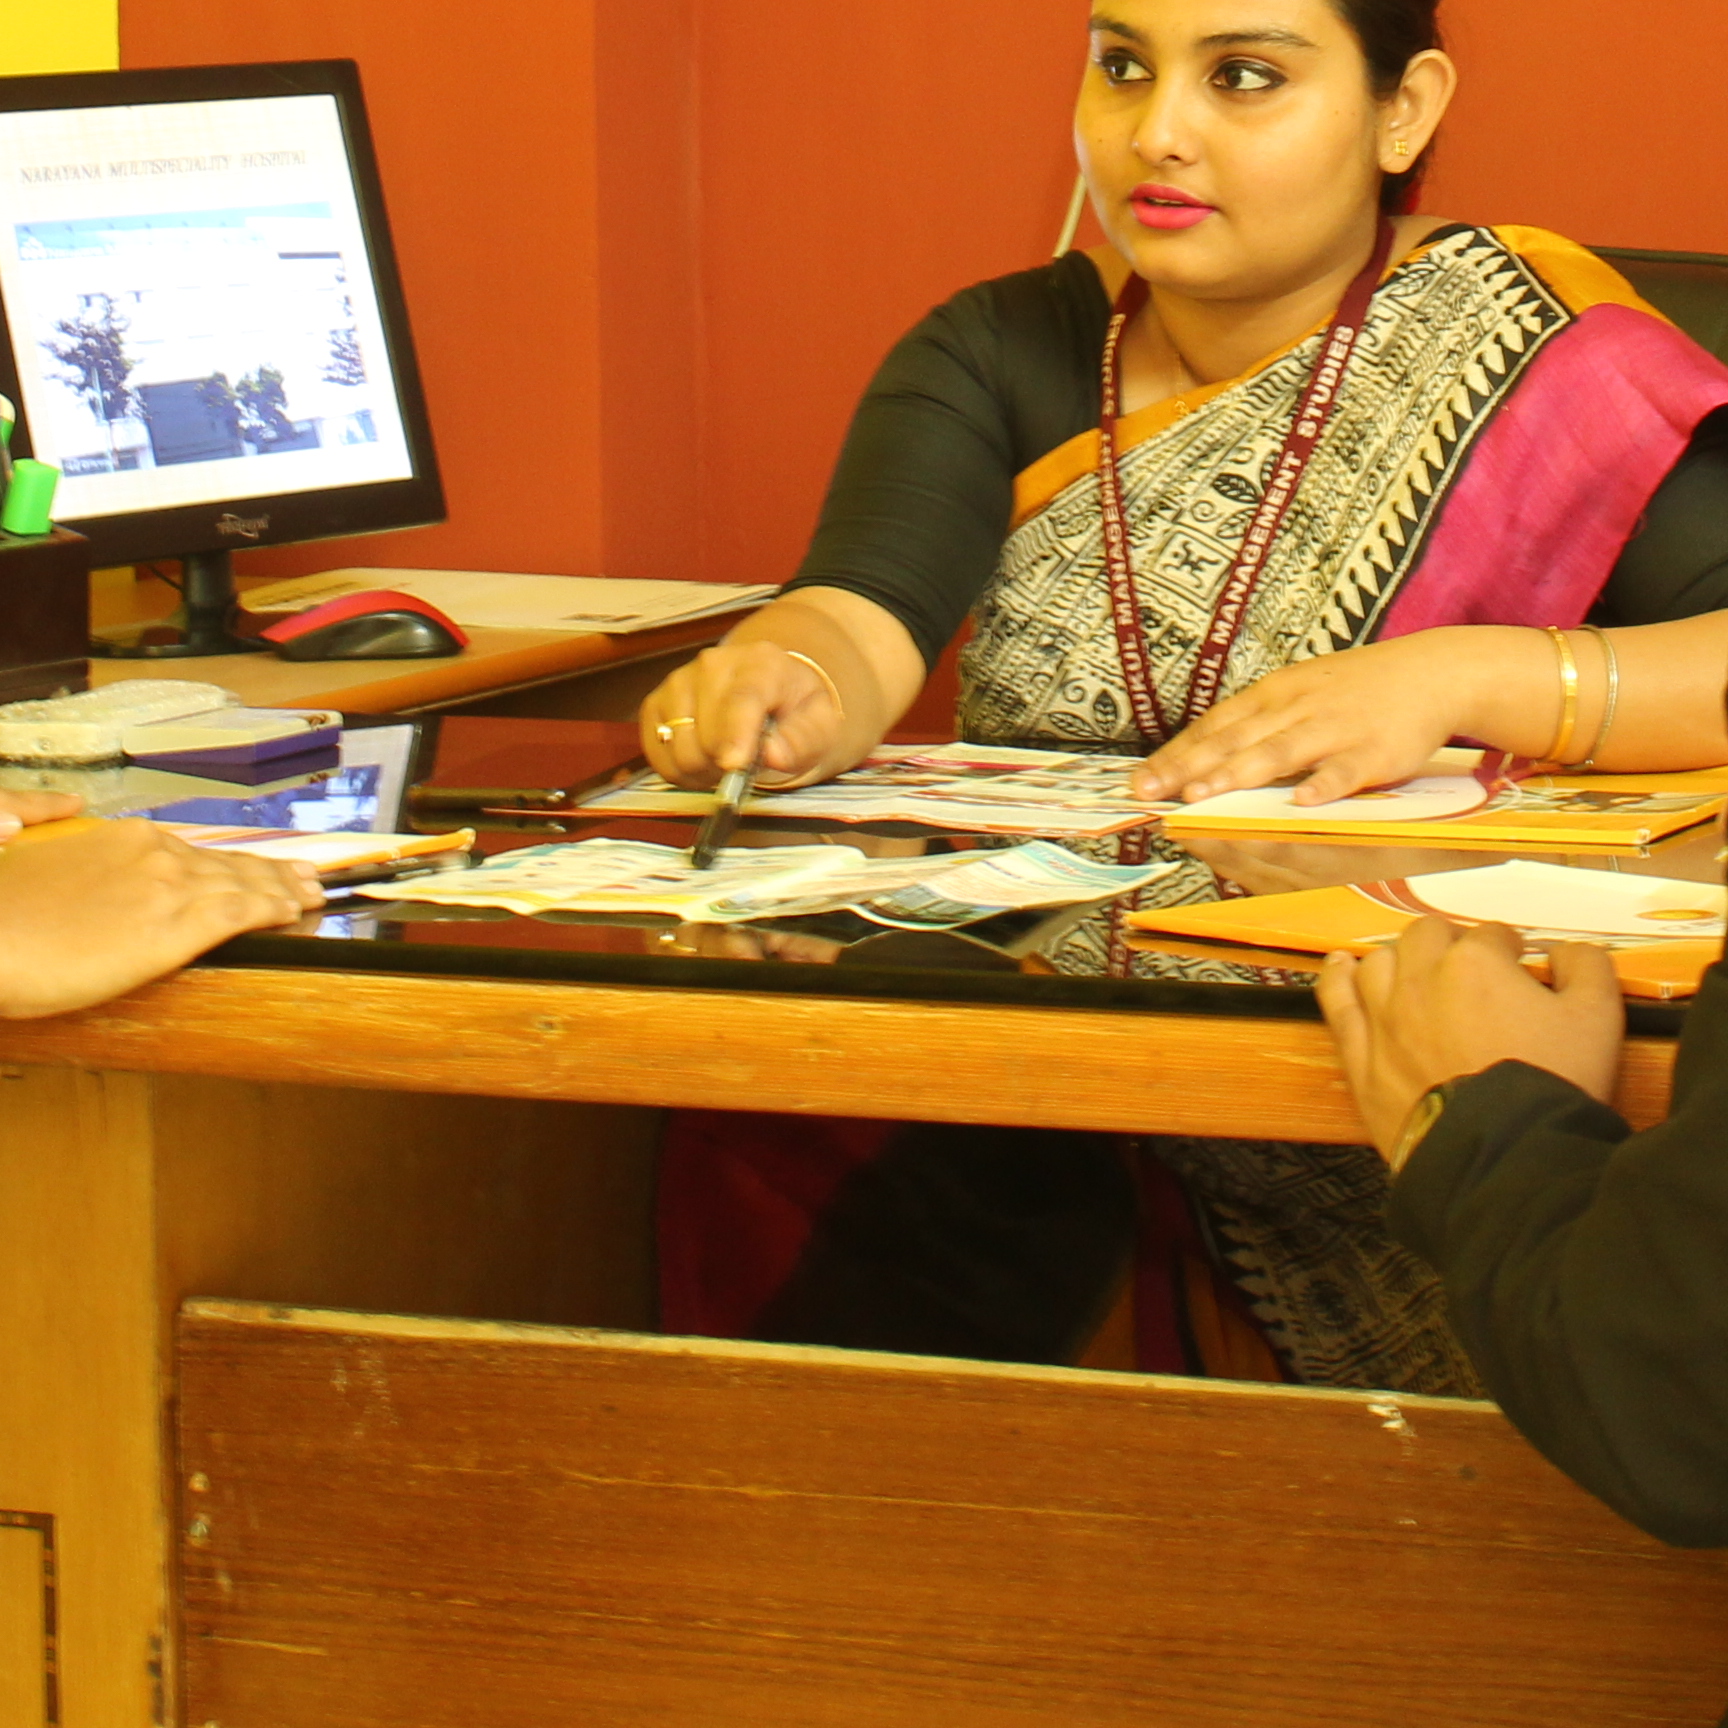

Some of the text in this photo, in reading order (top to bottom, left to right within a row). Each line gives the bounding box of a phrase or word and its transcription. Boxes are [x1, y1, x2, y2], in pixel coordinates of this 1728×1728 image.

[19, 164, 102, 184] NARAYANA
[1101, 433, 1134, 626] MANAGEMENT
[1211, 451, 1301, 646] MANAGEMENT
[1296, 325, 1354, 438] STUDIES
